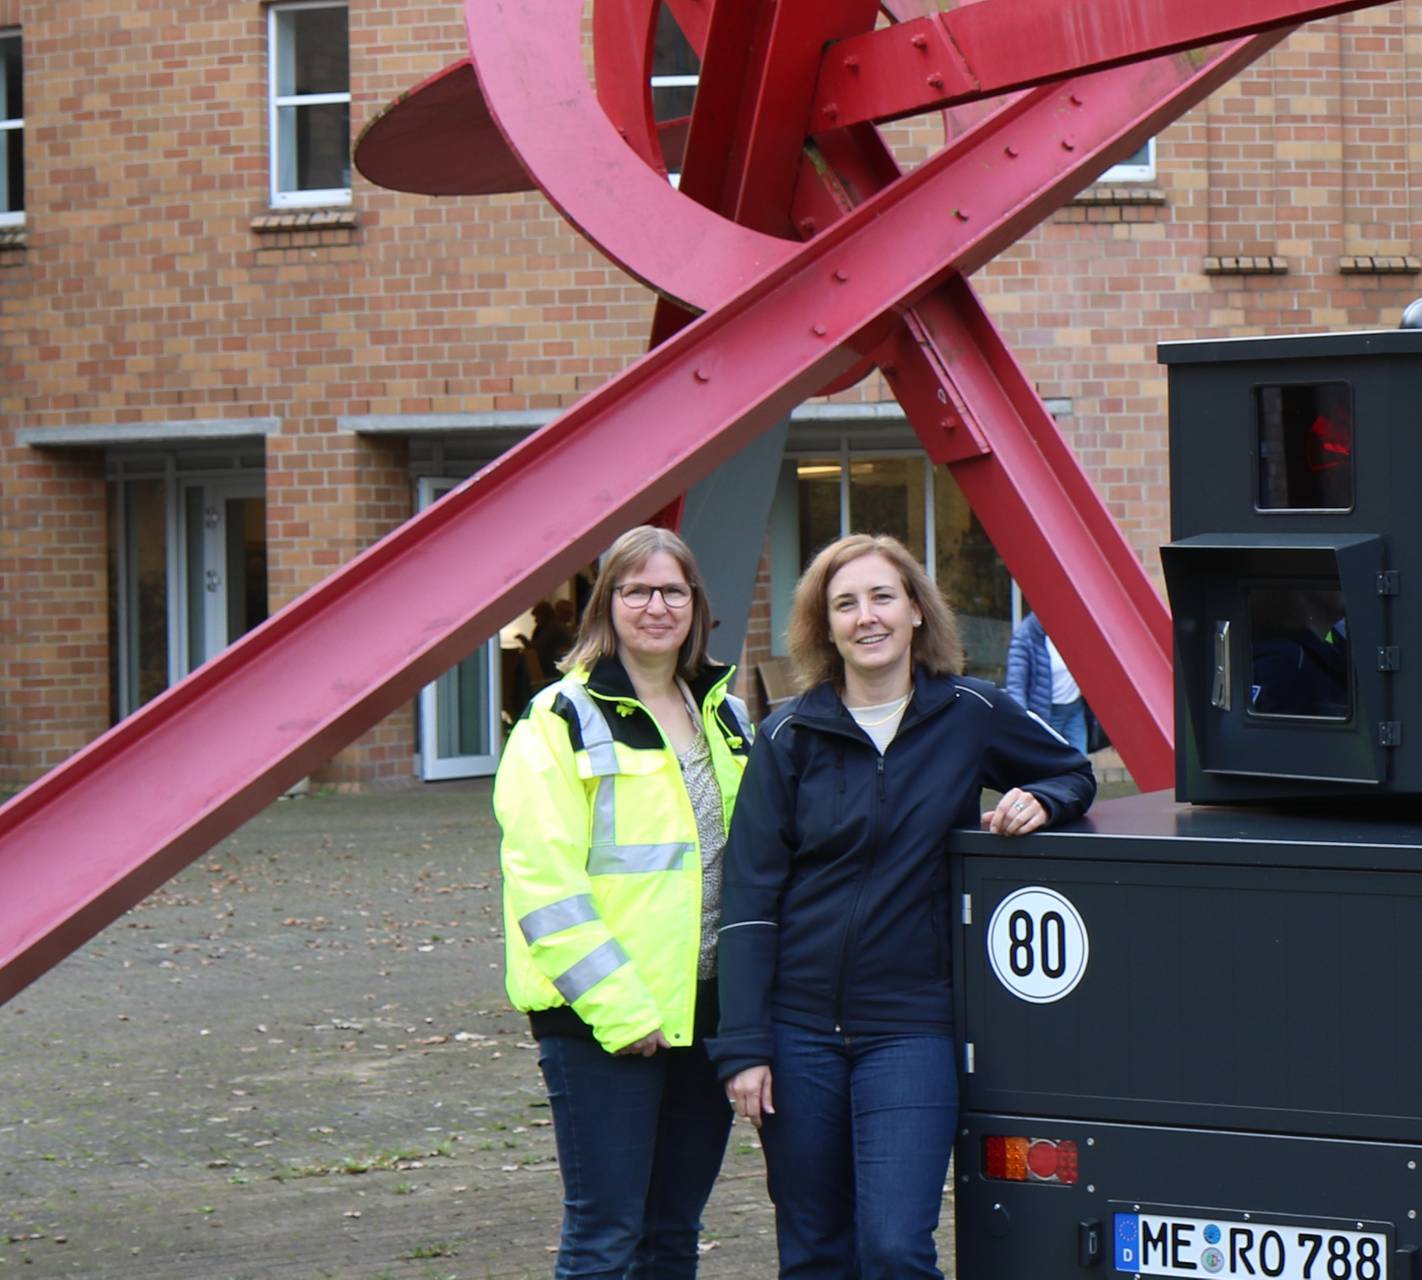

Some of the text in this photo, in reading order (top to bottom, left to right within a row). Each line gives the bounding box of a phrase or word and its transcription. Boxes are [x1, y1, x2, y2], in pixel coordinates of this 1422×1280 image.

[1009, 909, 1066, 979] 80
[1122, 1247, 1134, 1263] D
[1142, 1220, 1381, 1280] ME RO 788
